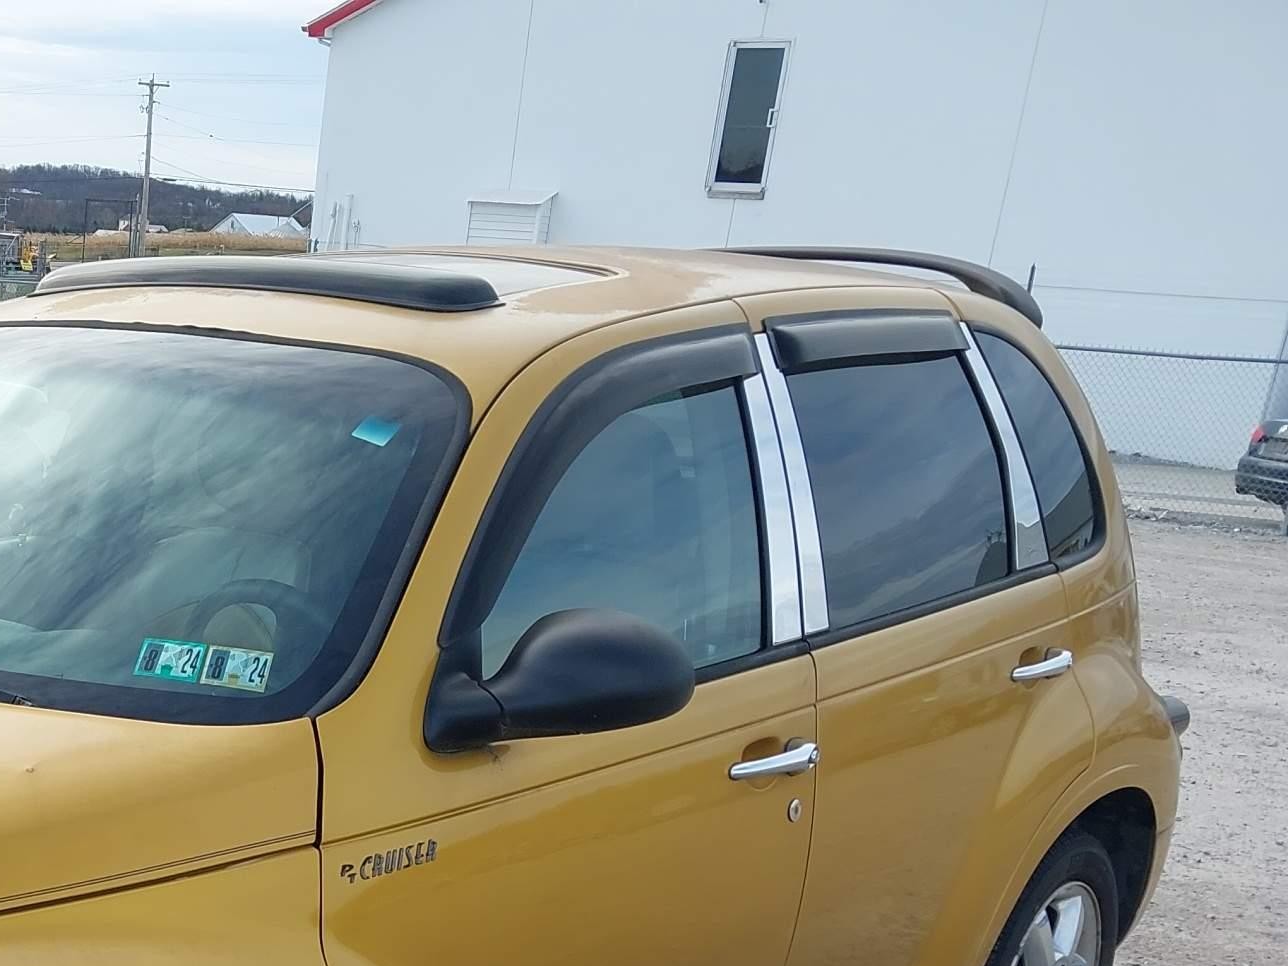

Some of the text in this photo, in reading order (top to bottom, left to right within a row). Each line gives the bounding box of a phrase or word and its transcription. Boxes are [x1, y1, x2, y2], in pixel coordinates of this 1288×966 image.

[181, 648, 200, 674] 24
[248, 657, 268, 684] 24
[340, 839, 438, 884] PT CRUISER
